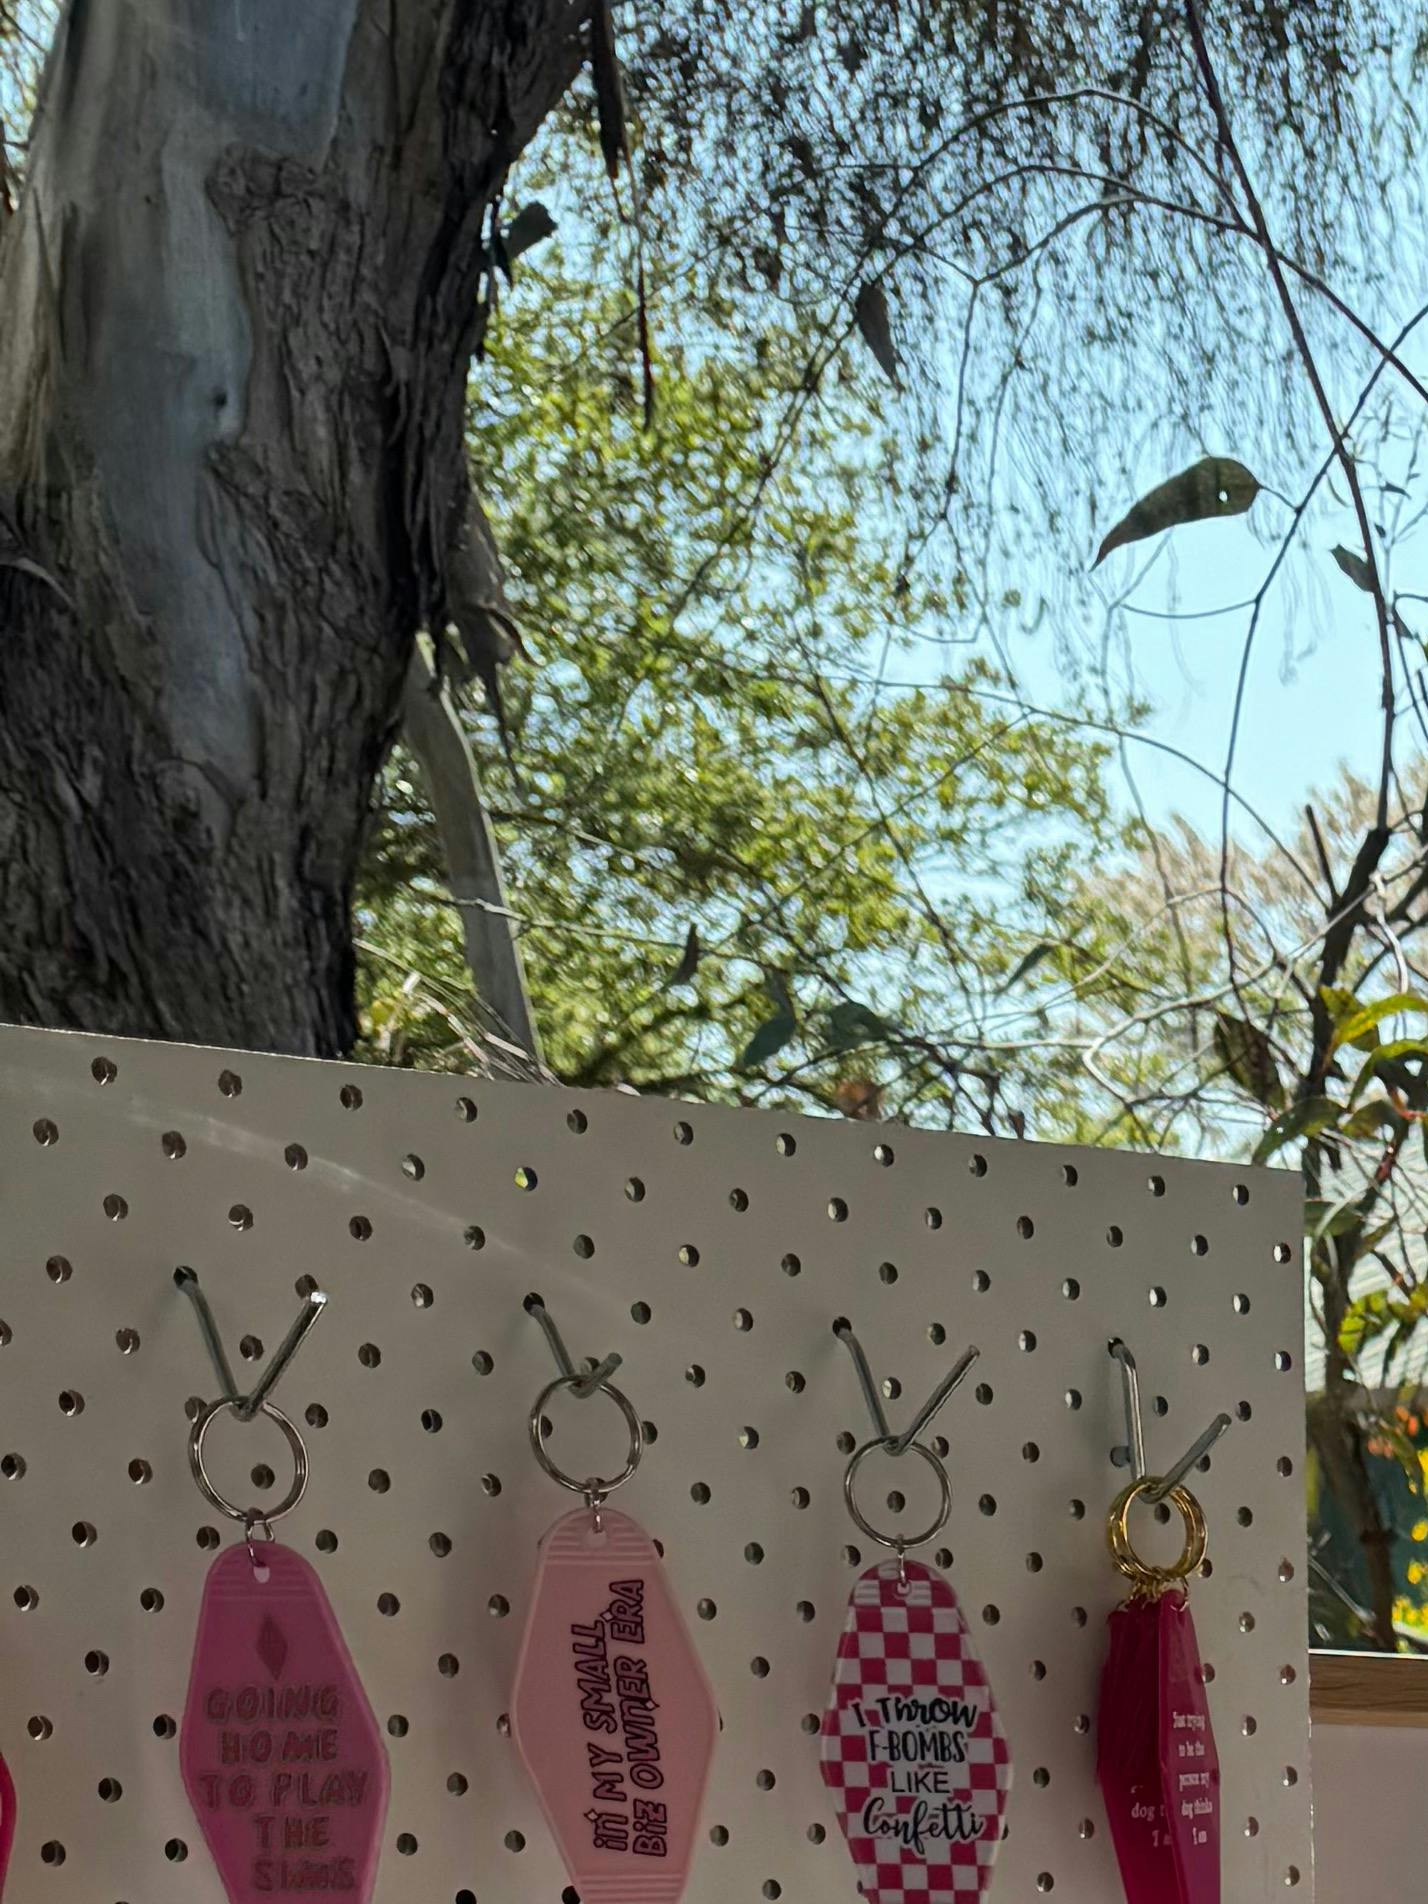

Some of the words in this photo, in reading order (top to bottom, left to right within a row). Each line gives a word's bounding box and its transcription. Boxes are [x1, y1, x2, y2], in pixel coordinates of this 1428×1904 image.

[609, 1579, 645, 1644] ERA
[571, 1620, 617, 1733] SMALL
[869, 1730, 967, 1763] F-BOMBS
[200, 1773, 254, 1808] TO
[273, 1771, 368, 1807] PLAY
[588, 1744, 627, 1801] MY
[891, 1771, 950, 1793] LIKE
[254, 1816, 330, 1848] THE
[863, 1797, 984, 1854] Confetti
